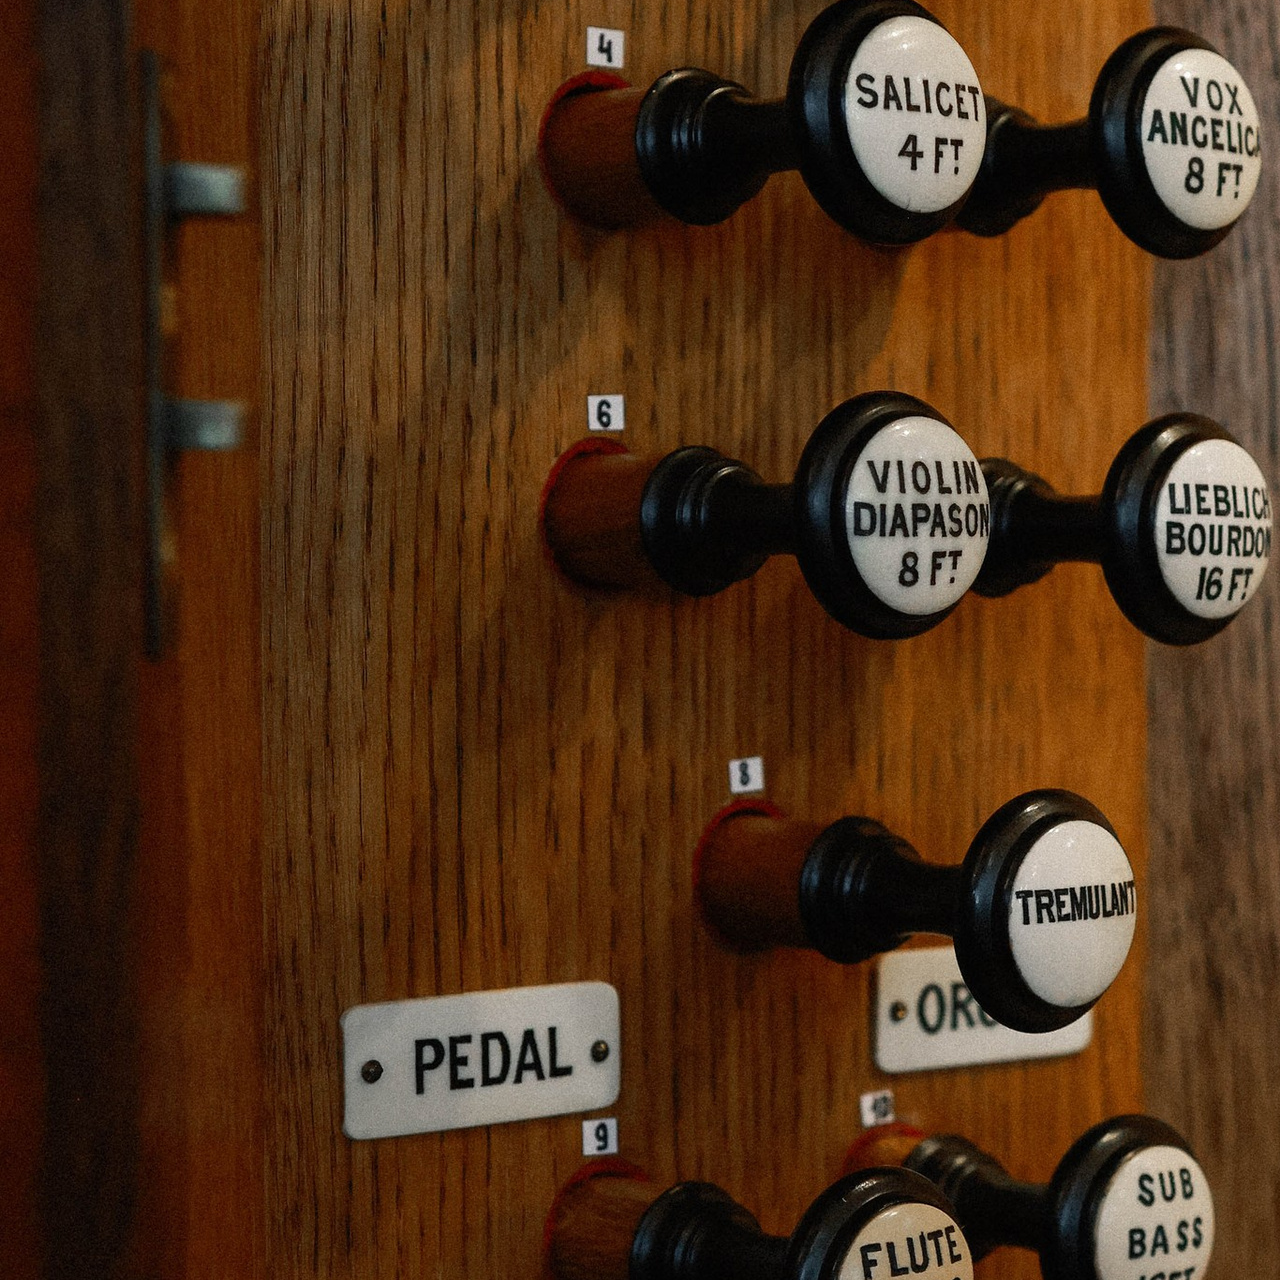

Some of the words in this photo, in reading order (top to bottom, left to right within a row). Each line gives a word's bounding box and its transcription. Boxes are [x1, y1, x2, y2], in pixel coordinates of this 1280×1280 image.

[598, 33, 613, 63] 4
[855, 72, 984, 122] SALICET
[1179, 75, 1243, 116] VOX
[898, 134, 924, 171] 4
[1184, 156, 1204, 195] 8
[597, 400, 612, 428] 6
[866, 458, 981, 496] VIOLIN
[851, 501, 992, 539] DIAPASON
[898, 549, 919, 587] 8
[1197, 565, 1223, 601] 16
[738, 761, 751, 786] 8
[1016, 879, 1137, 926] TREMULANT
[413, 1025, 573, 1096] PEDAL
[595, 1122, 609, 1151] 9
[1137, 1167, 1195, 1207] SUB
[1128, 1217, 1204, 1260] BASS
